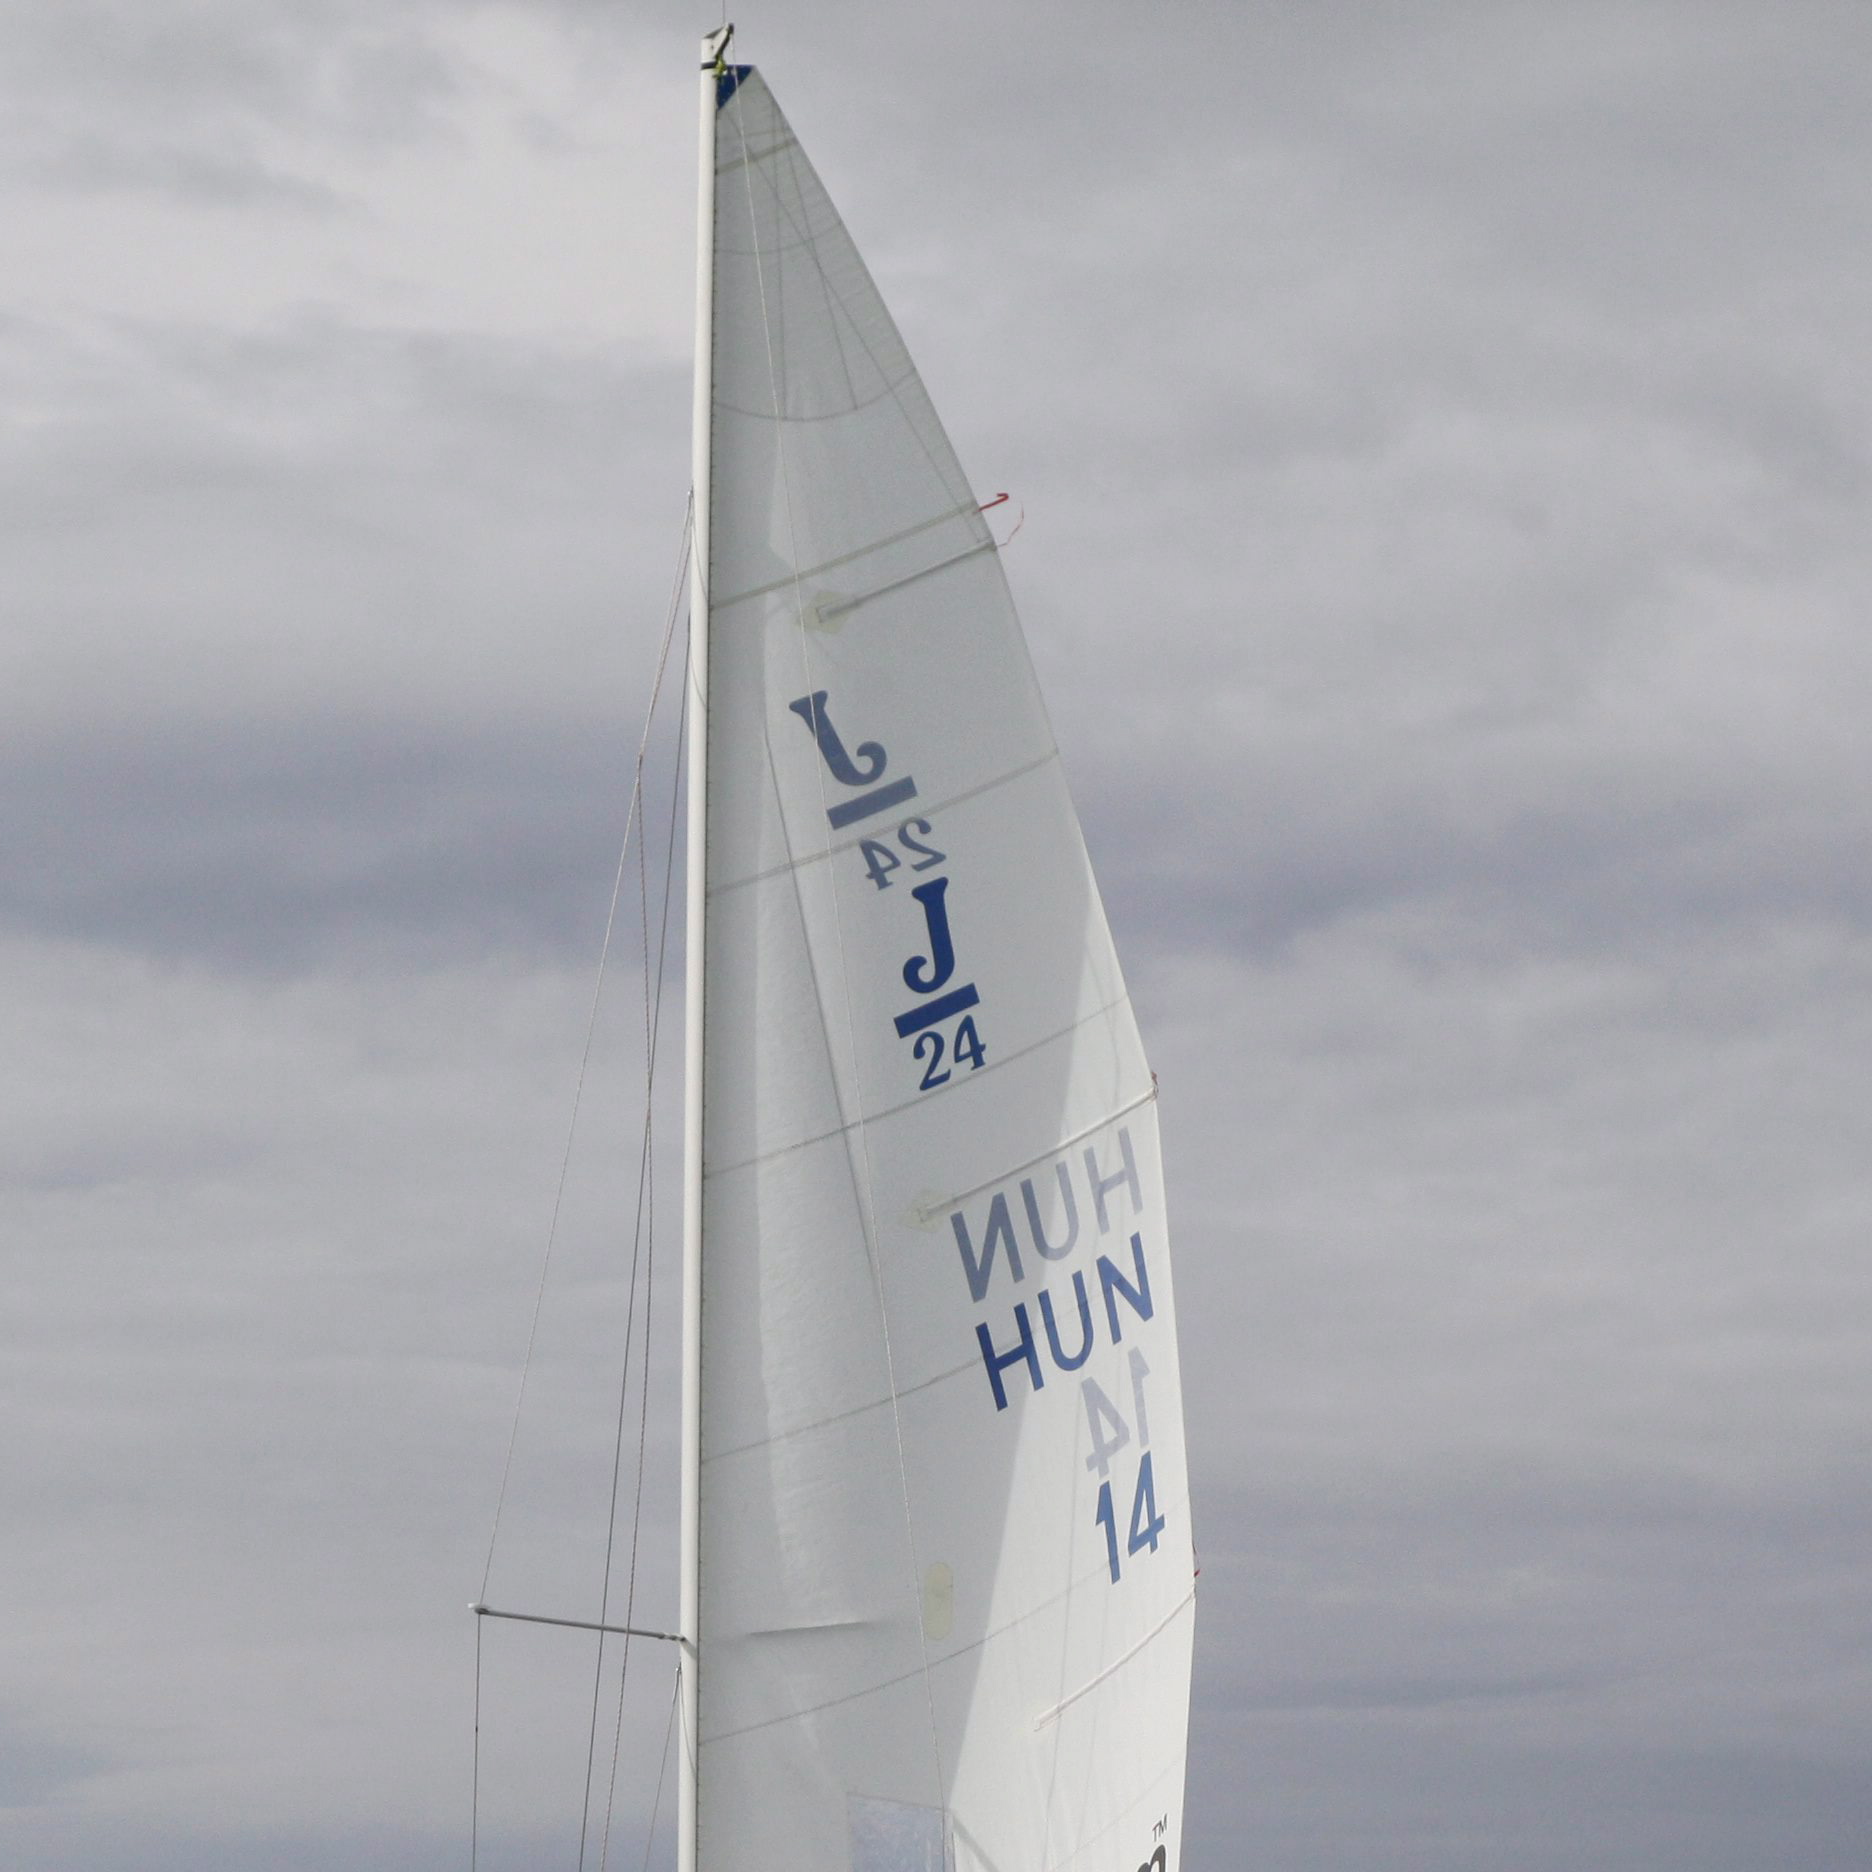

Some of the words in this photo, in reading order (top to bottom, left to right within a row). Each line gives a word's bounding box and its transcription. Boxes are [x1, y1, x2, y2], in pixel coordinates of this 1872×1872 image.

[902, 876, 955, 995] J
[913, 1014, 987, 1092] 24
[975, 1231, 1154, 1412] HUN
[1094, 1450, 1166, 1585] 14
